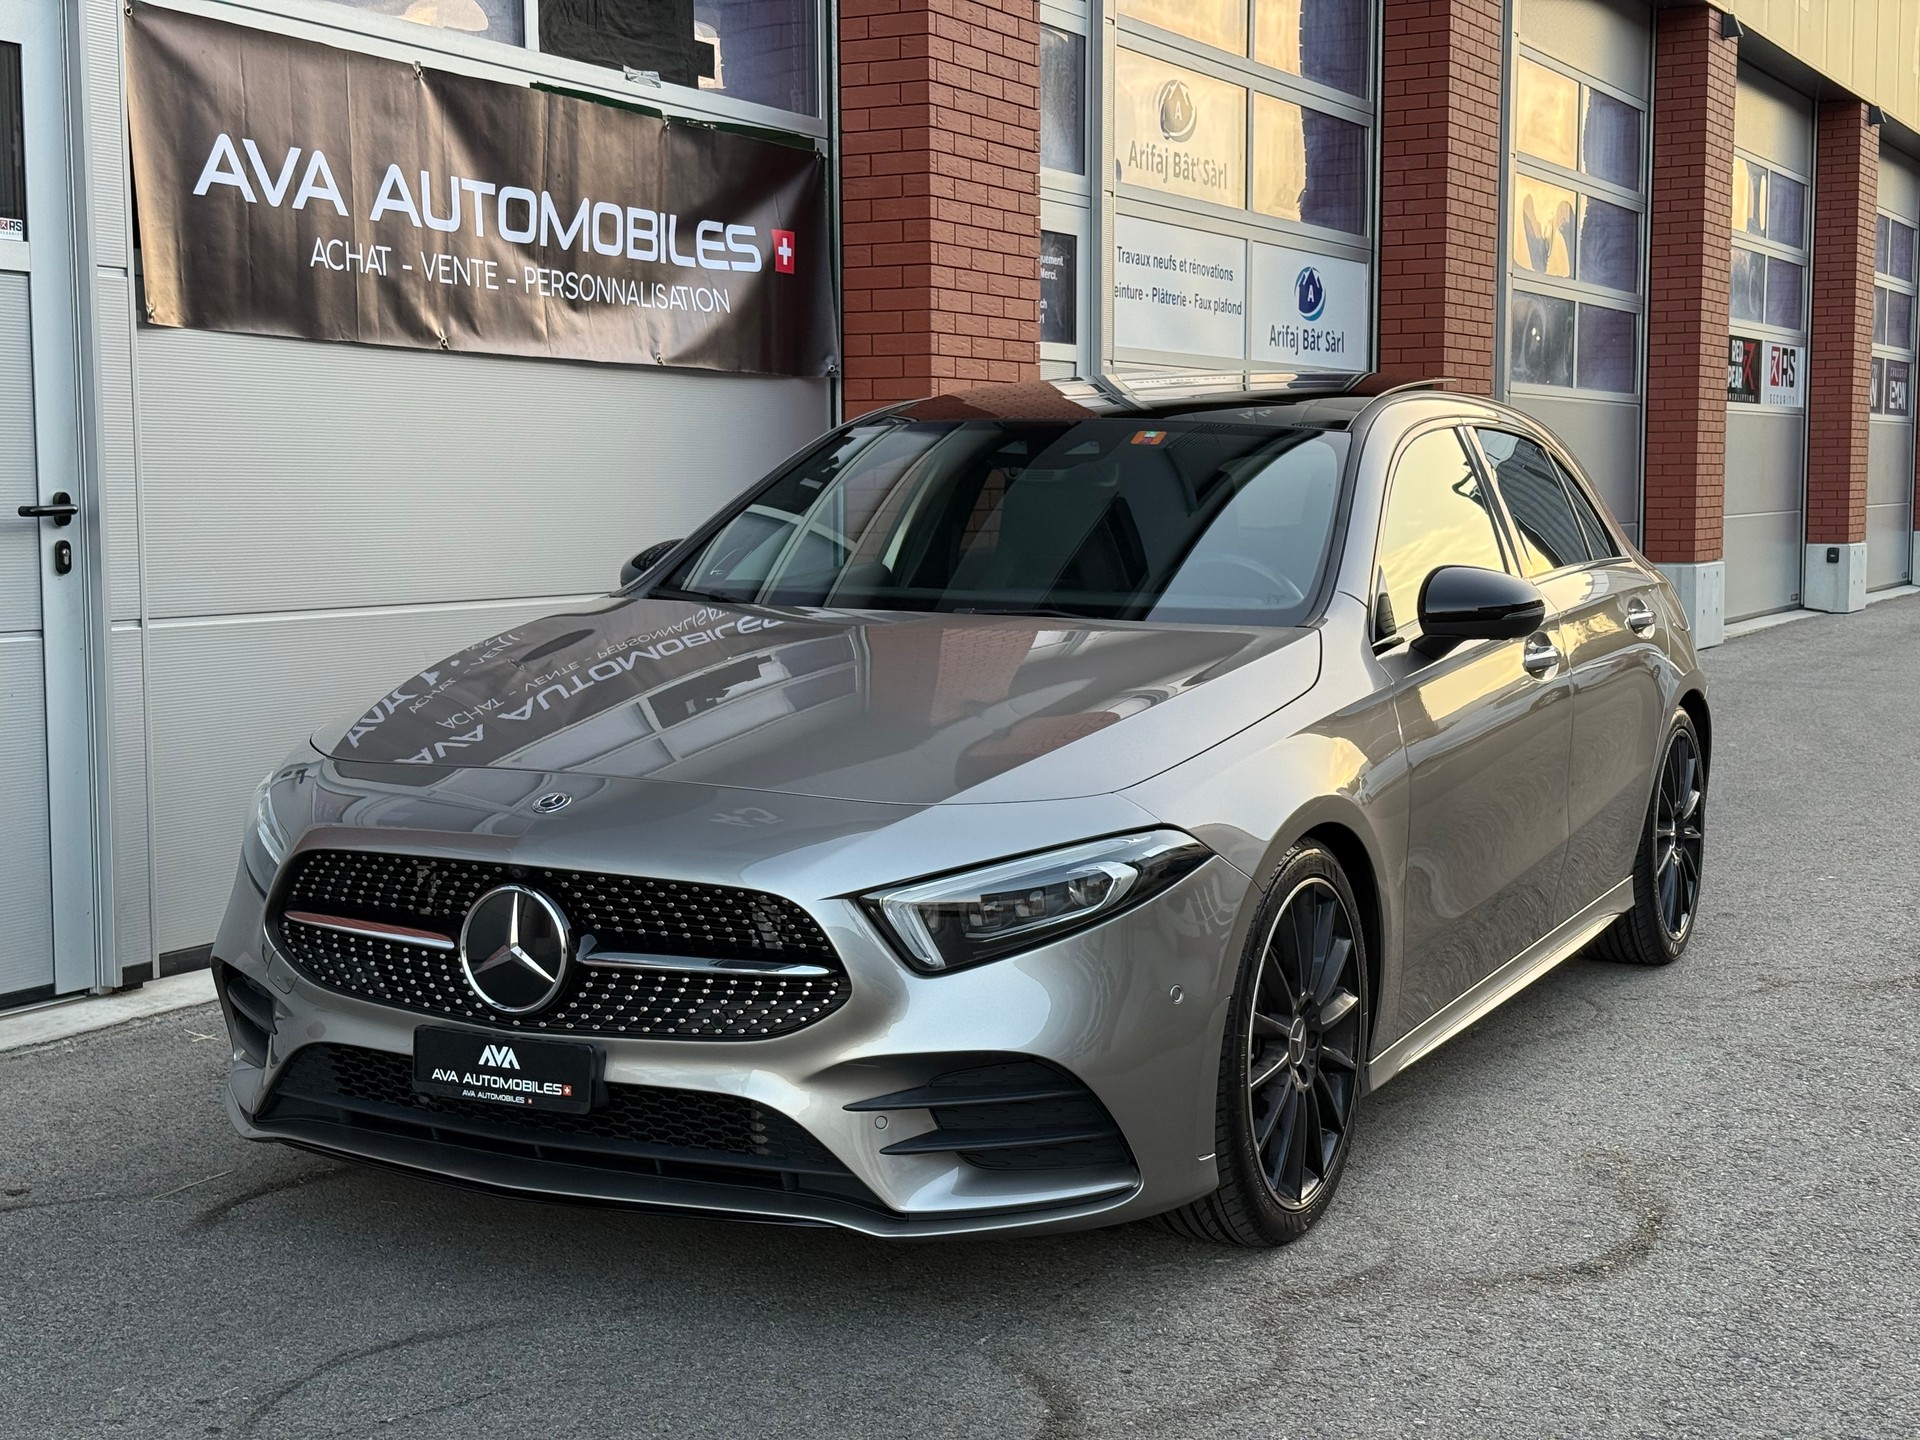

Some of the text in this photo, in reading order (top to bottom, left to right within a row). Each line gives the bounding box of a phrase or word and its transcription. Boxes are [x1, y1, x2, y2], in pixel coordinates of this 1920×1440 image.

[1128, 140, 1168, 184] Arifaj
[1203, 159, 1227, 190] Sàrl
[193, 133, 762, 273] AVA AUTOMOBILES
[310, 237, 391, 276] ACHAT
[420, 251, 499, 290] VENTE
[524, 266, 731, 313] PERSONNALISATION
[1117, 246, 1234, 281] Travaux neufs et rénovations
[1114, 282, 1143, 301] einture
[1152, 287, 1187, 307] Plâtrerie
[1194, 293, 1212, 311] Faux
[1214, 297, 1242, 315] plafond
[1269, 324, 1299, 355] Arifaj
[1325, 330, 1345, 353] Sàrl
[1732, 339, 1744, 363] RED
[478, 1044, 521, 1070] AVA
[431, 1068, 562, 1096] AVA AUTOMOBILES
[462, 1089, 525, 1104] AVA AUTOMOBILES
